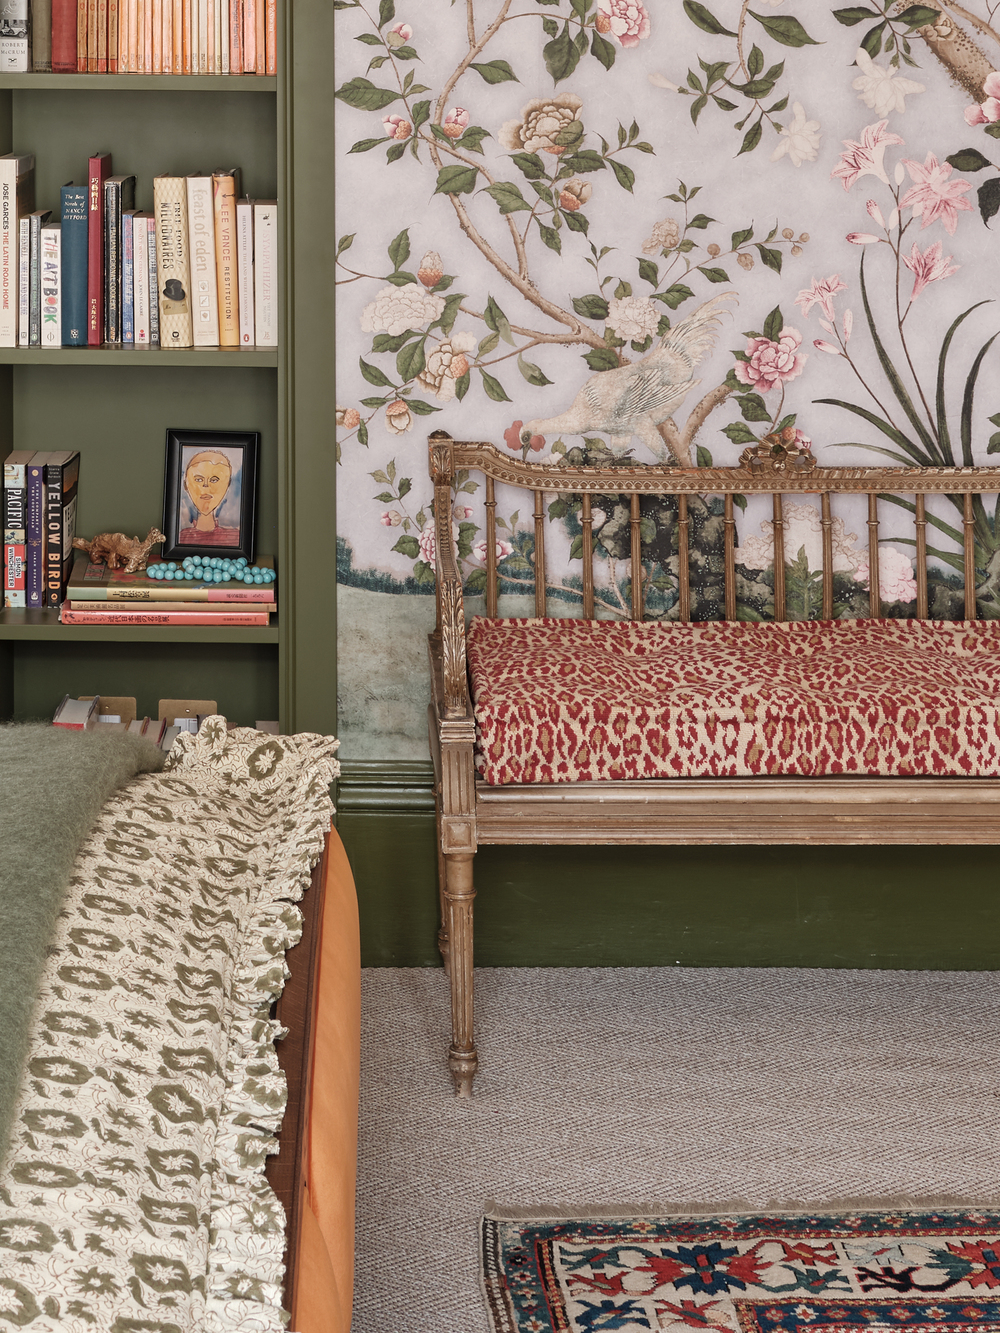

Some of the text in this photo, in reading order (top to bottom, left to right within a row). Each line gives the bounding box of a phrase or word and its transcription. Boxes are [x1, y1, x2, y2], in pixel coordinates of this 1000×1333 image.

[161, 202, 174, 270] MILLIONAIRES
[174, 202, 182, 257] FREE FOOD
[192, 189, 210, 272] feast of eden
[221, 204, 232, 320] LEE VANCE RESTITUTION
[262, 233, 271, 301] SYMPATHIZER
[43, 233, 58, 324] THE ART BOOK
[7, 488, 22, 529] PACIFIC
[48, 482, 61, 590] YELLOW BIRD
